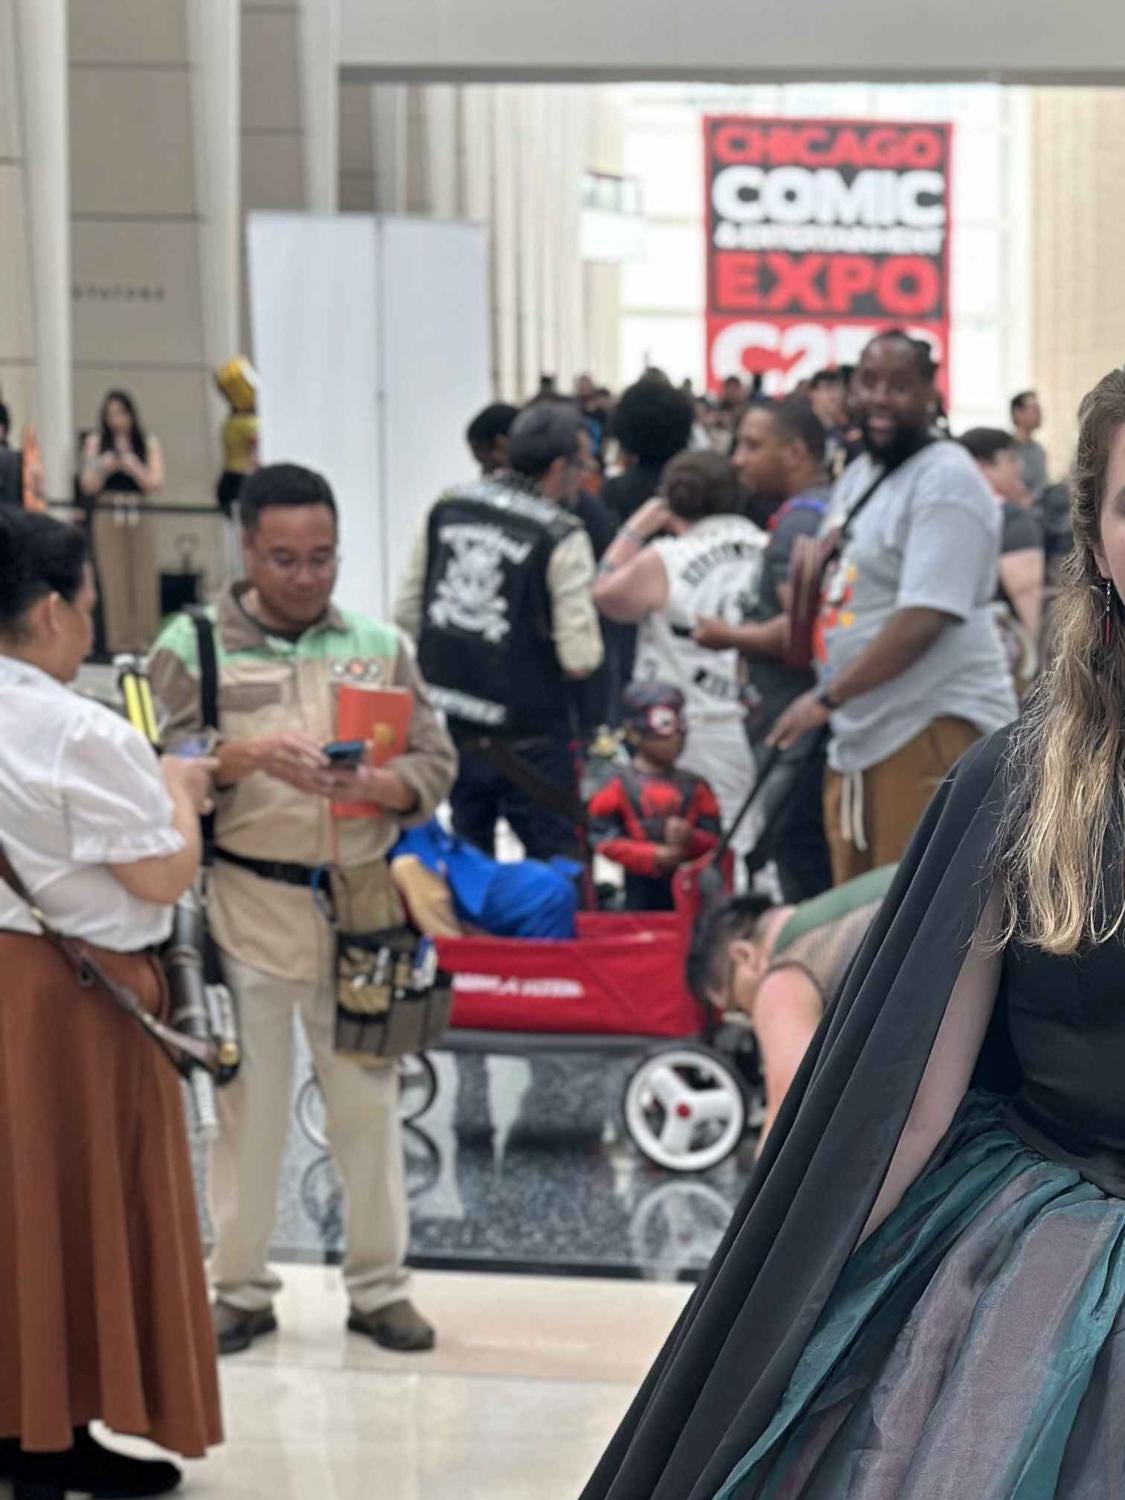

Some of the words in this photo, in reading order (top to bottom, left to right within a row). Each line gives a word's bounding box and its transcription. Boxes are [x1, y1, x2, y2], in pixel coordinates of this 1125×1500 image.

[712, 165, 944, 220] COMIC
[716, 252, 939, 316] EXPO
[712, 321, 943, 397] C2
